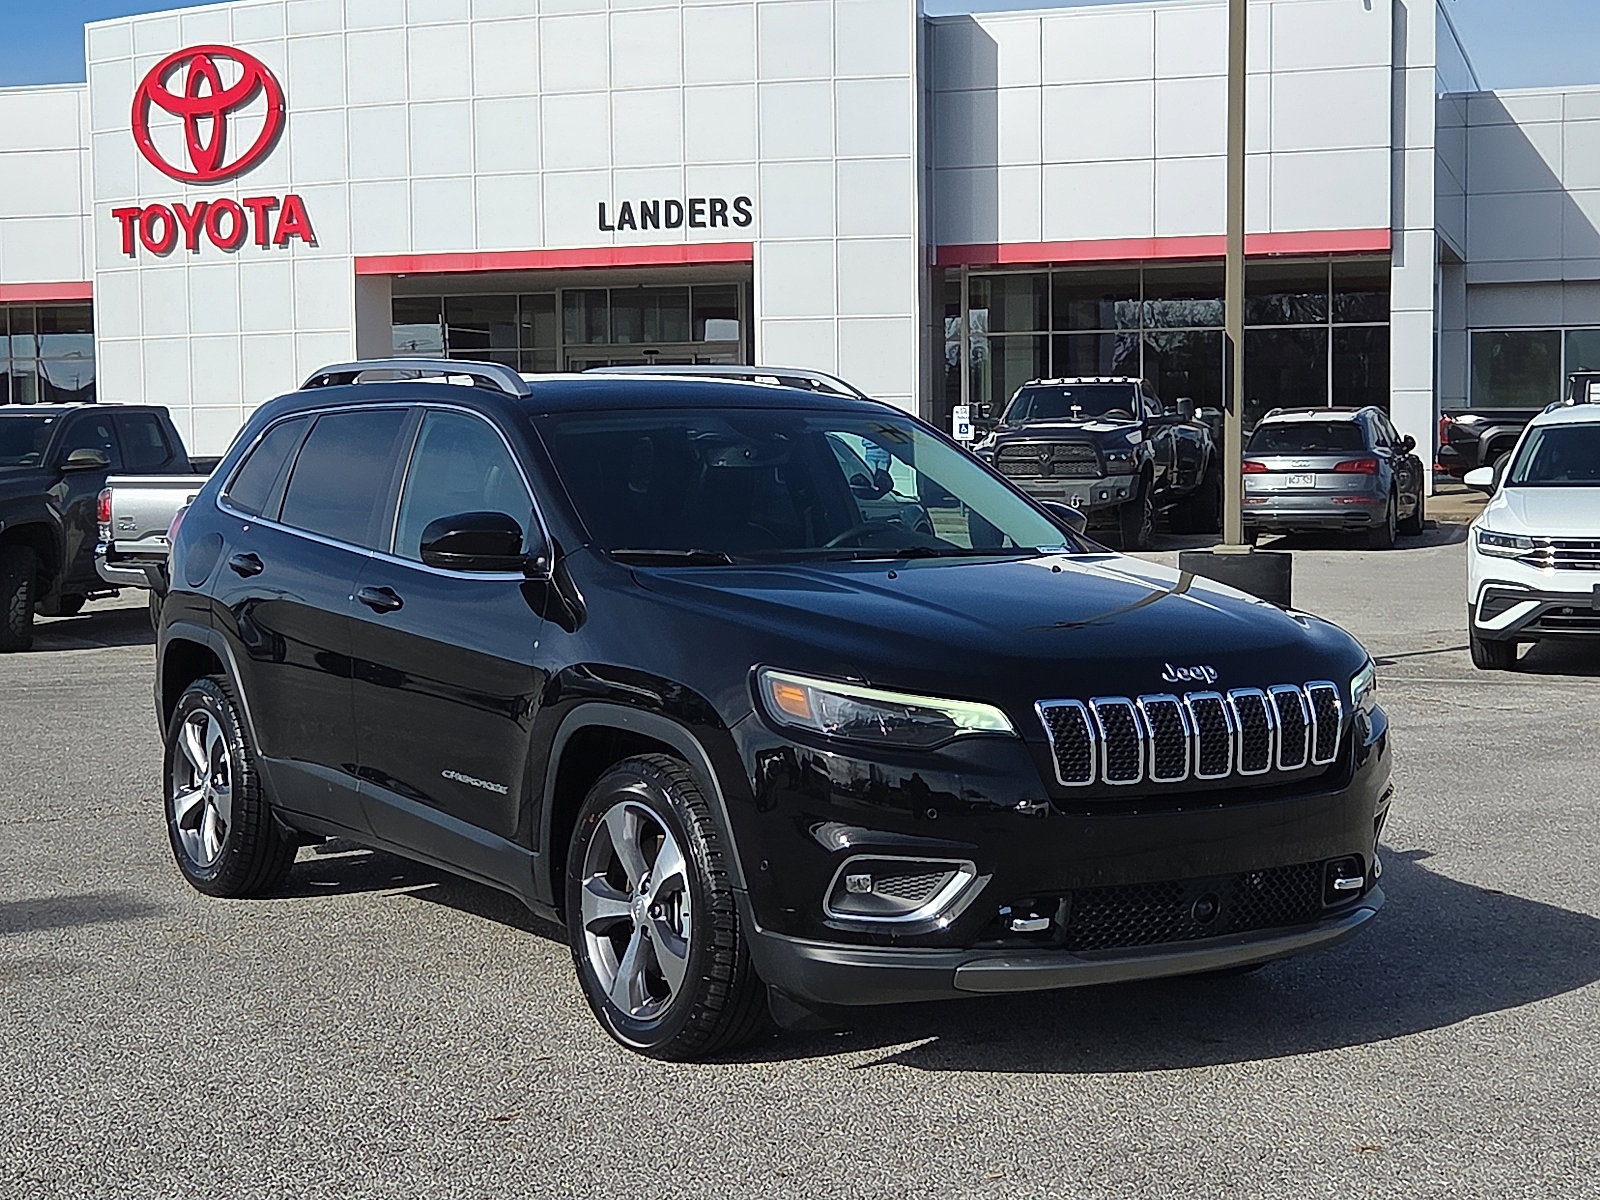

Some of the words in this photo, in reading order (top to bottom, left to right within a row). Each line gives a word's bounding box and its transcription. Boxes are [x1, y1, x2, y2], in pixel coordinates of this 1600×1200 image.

[112, 194, 316, 255] TOYOTA
[598, 196, 753, 231] LANDERS
[1161, 662, 1218, 684] Jeep
